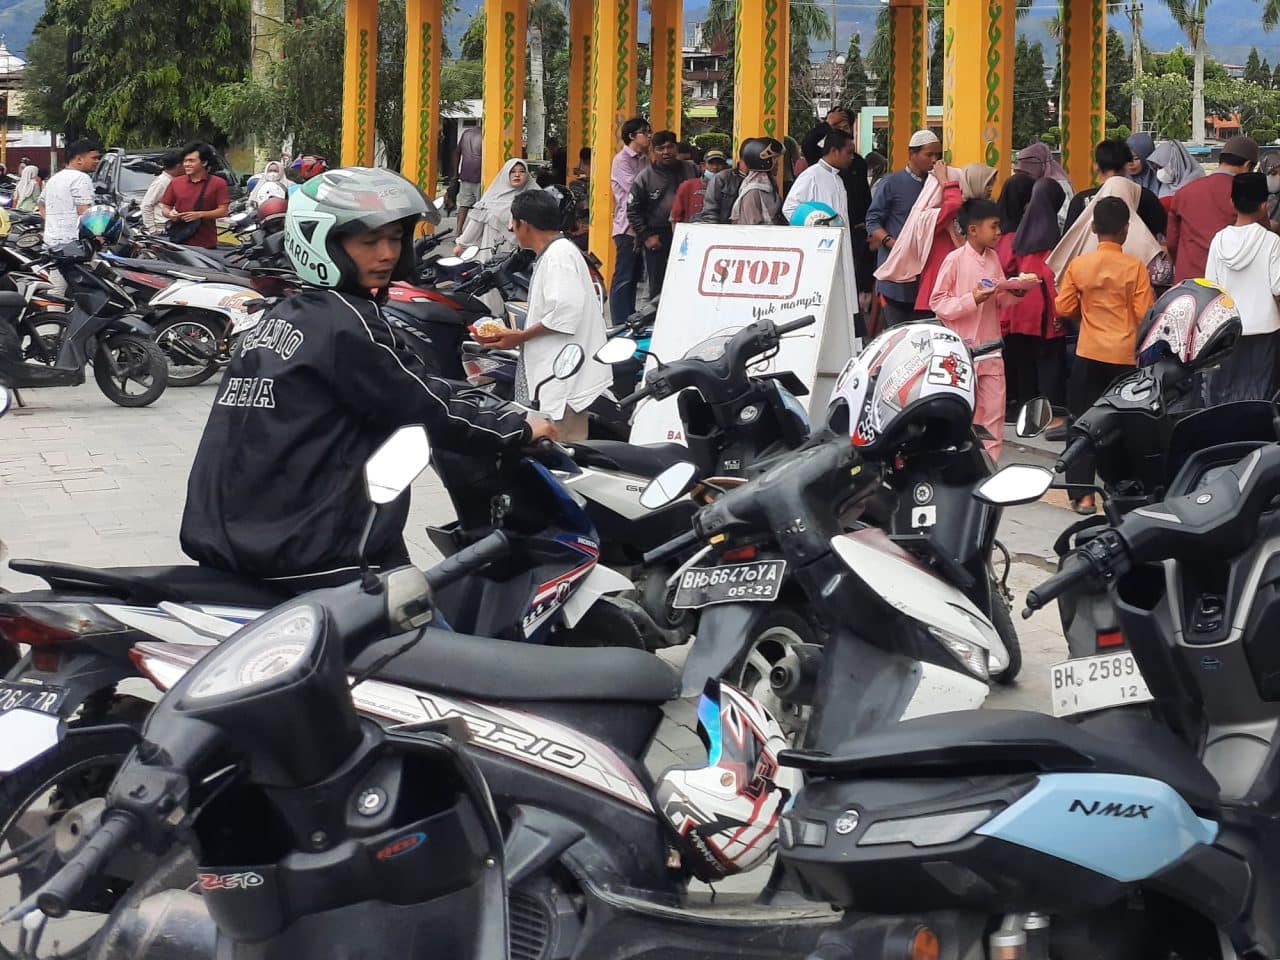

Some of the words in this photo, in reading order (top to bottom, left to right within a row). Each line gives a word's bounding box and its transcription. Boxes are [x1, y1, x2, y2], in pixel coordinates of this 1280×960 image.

[710, 258, 790, 285] STOP
[752, 303, 776, 321] Yuk
[780, 291, 824, 311] mampir
[667, 430, 682, 440] BA
[709, 566, 750, 585] 6647
[757, 564, 778, 580] YA
[1055, 666, 1074, 689] BH
[1089, 657, 1134, 681] 2589
